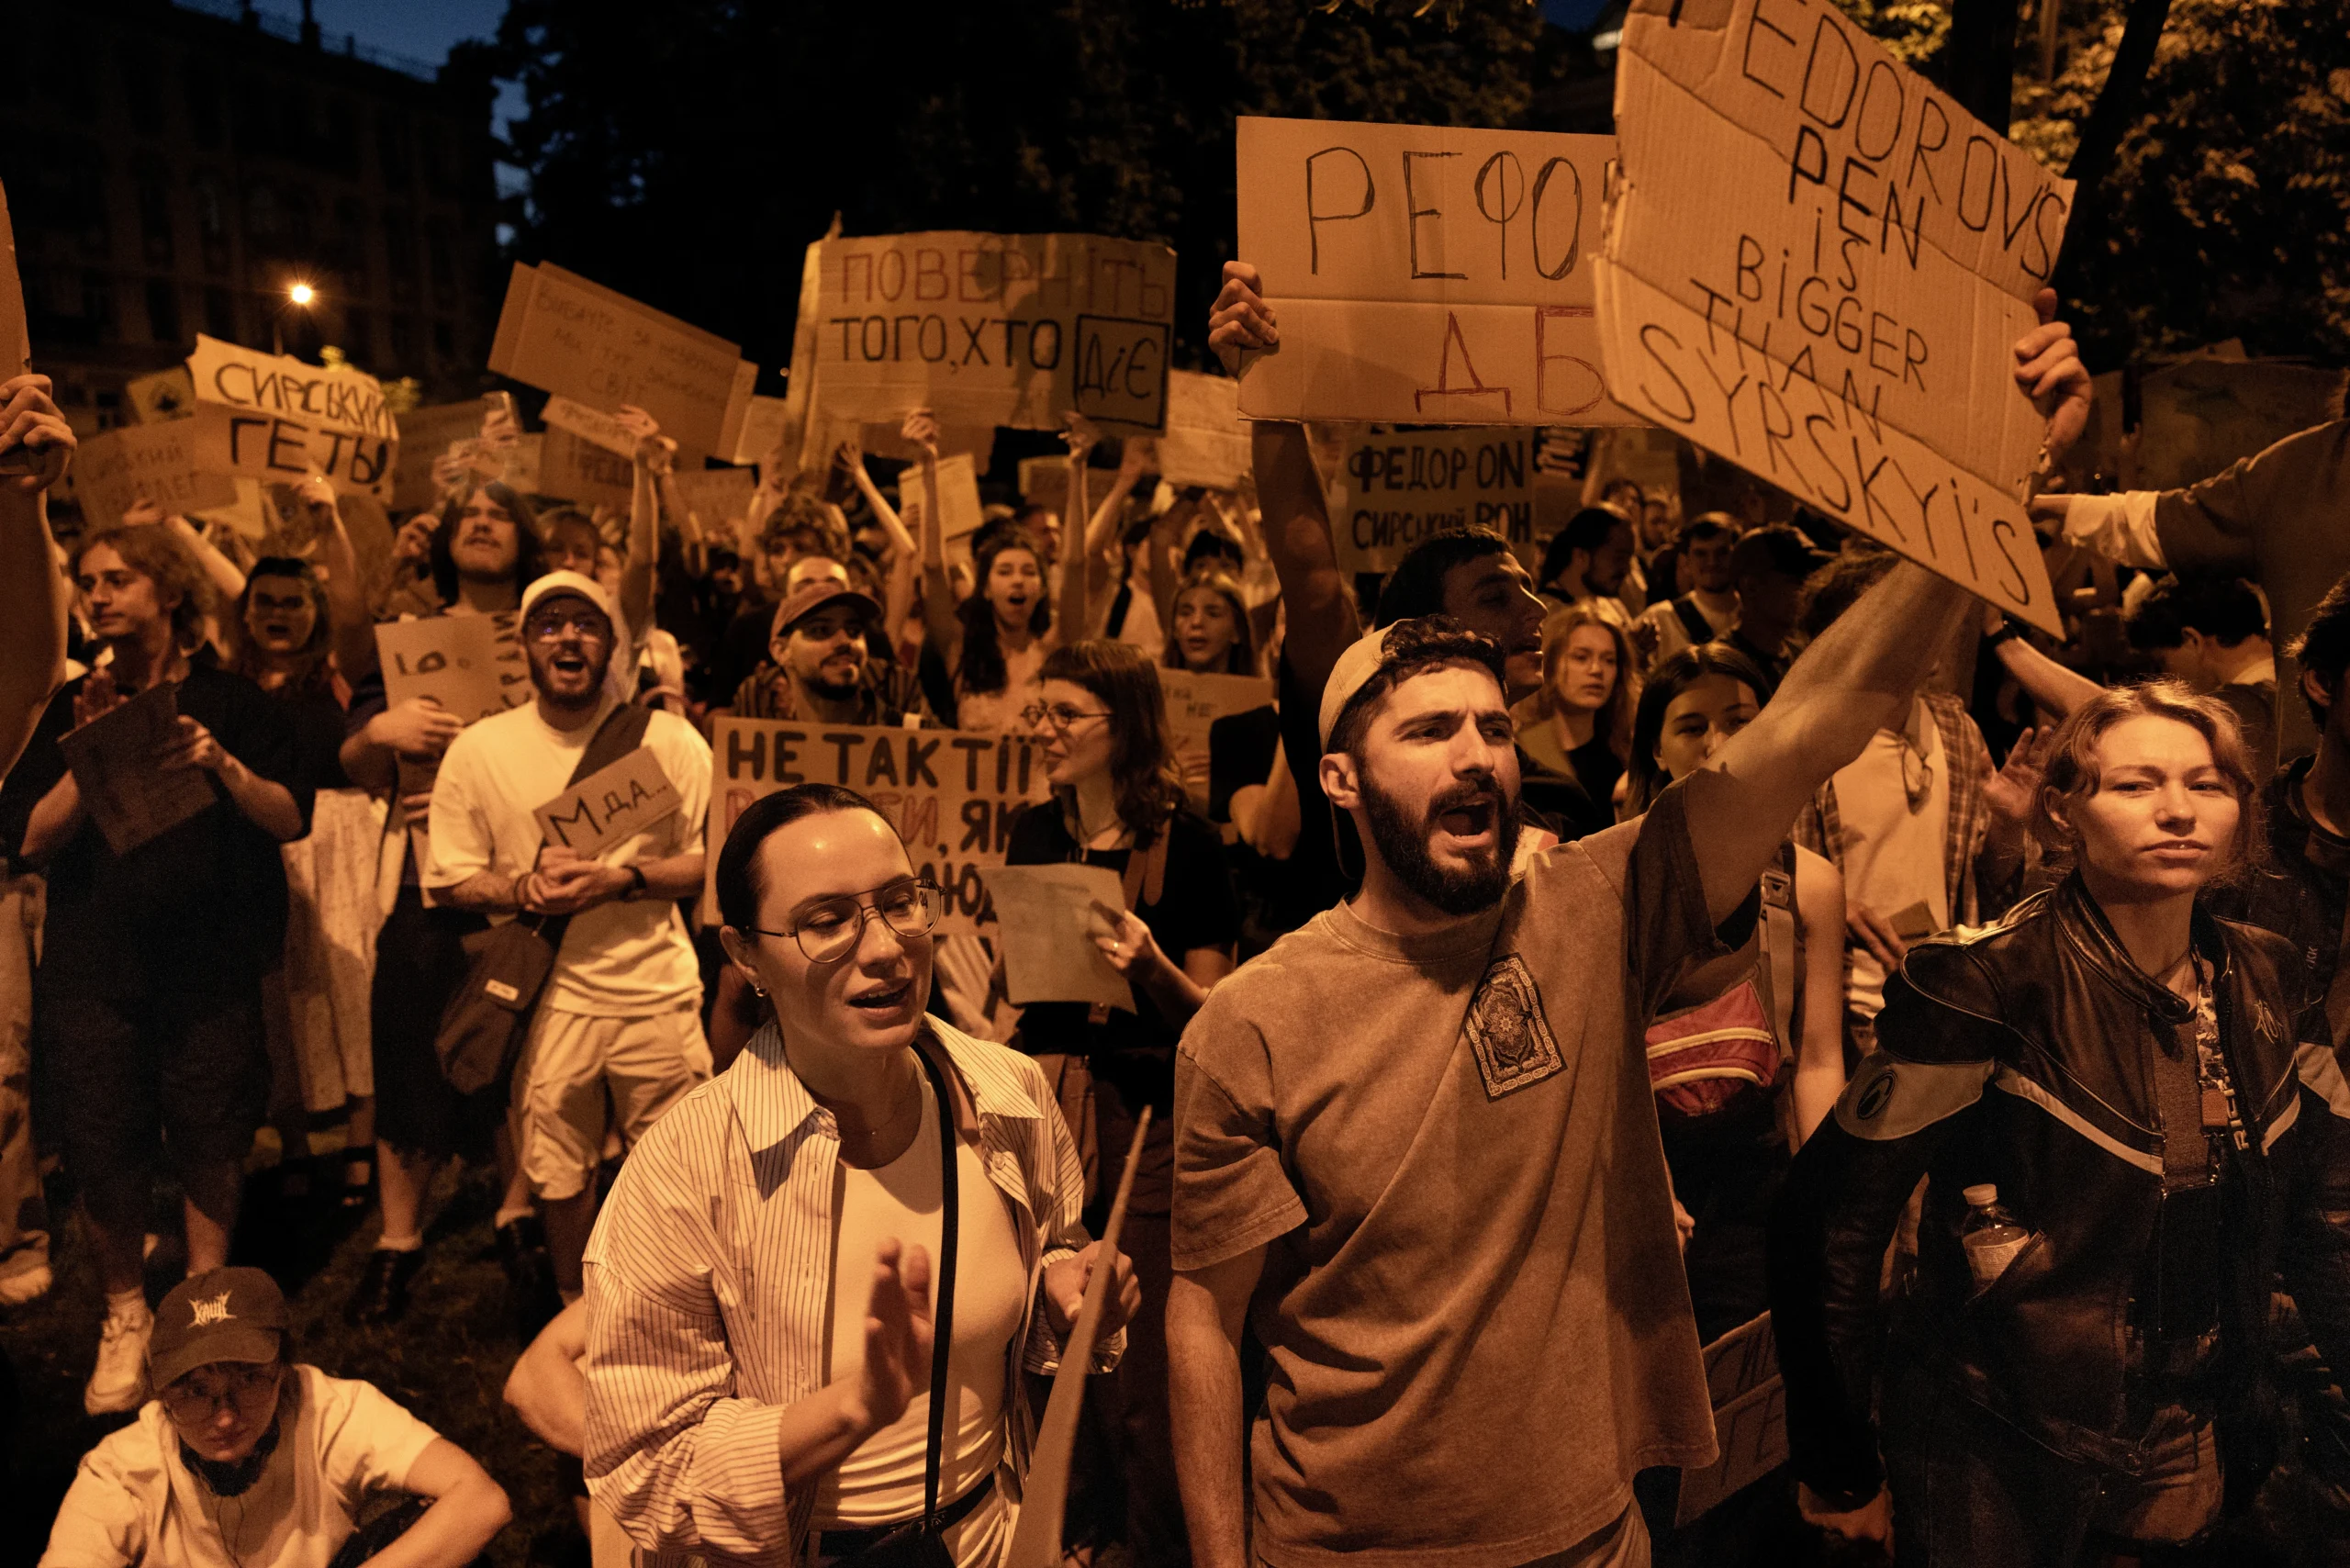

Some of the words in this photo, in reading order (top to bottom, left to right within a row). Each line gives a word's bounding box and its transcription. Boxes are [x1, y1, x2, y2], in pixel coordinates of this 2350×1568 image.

[1669, 0, 2066, 281] EDOROV'S
[1305, 146, 1617, 282] РЕФО
[1789, 125, 1925, 270] PEN
[842, 247, 1168, 319] ПОВЕРНІТЬ
[1689, 277, 1883, 446] THAN
[229, 416, 389, 496] ГЕТЬ!
[1348, 445, 1467, 493] ФЕДОР
[727, 729, 807, 783] НЕ
[823, 734, 940, 788] ТАК
